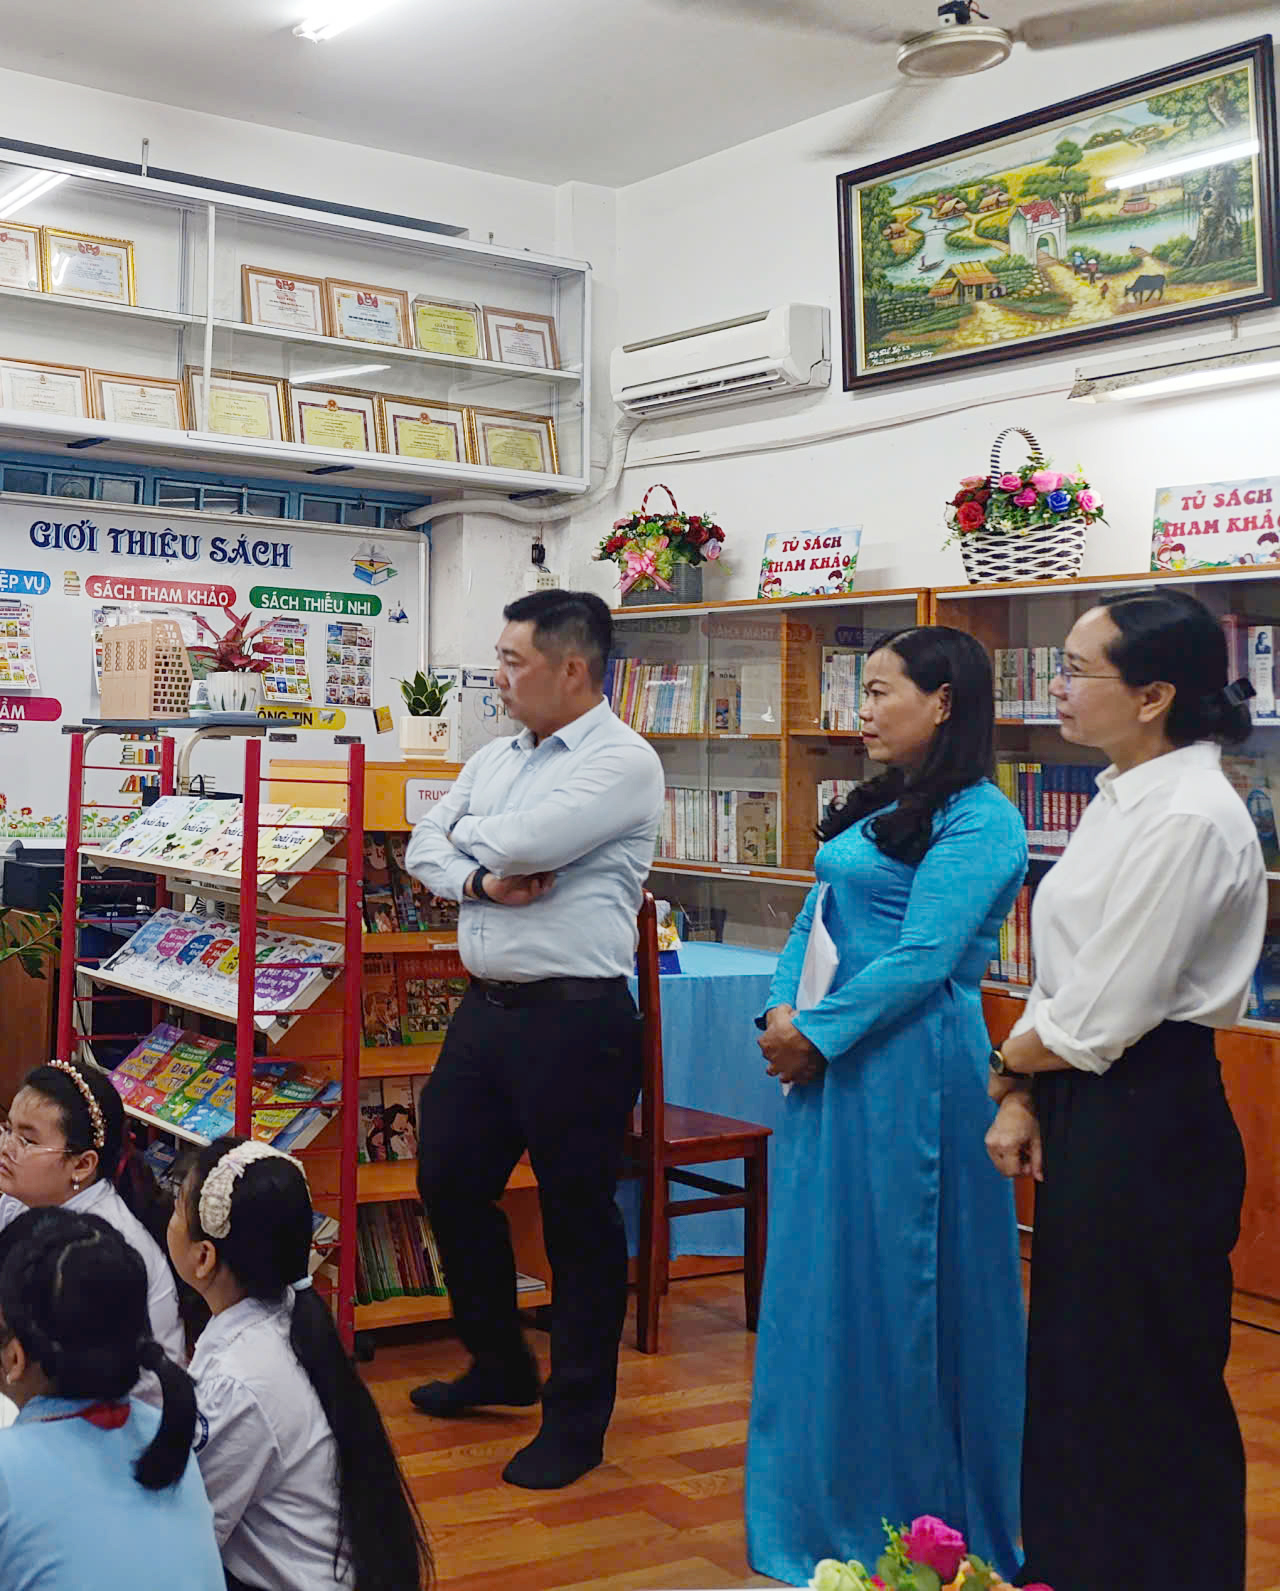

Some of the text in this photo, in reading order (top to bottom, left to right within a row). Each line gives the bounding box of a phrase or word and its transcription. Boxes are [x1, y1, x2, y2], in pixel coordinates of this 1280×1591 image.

[1181, 488, 1273, 511] TỦ SÁCH
[1163, 519, 1219, 537] THAM
[29, 519, 292, 567] GIỚI THIỆU SÁCH
[782, 535, 842, 552] TỦ SÁCH
[768, 552, 851, 573] THAM KHẢO
[22, 573, 46, 595] VỤ
[93, 578, 229, 607] SÁCH THAM KHẢO
[261, 591, 371, 616] SÁCH THIẾU NHI
[293, 711, 313, 725] TIN
[418, 790, 449, 801] TRUY
